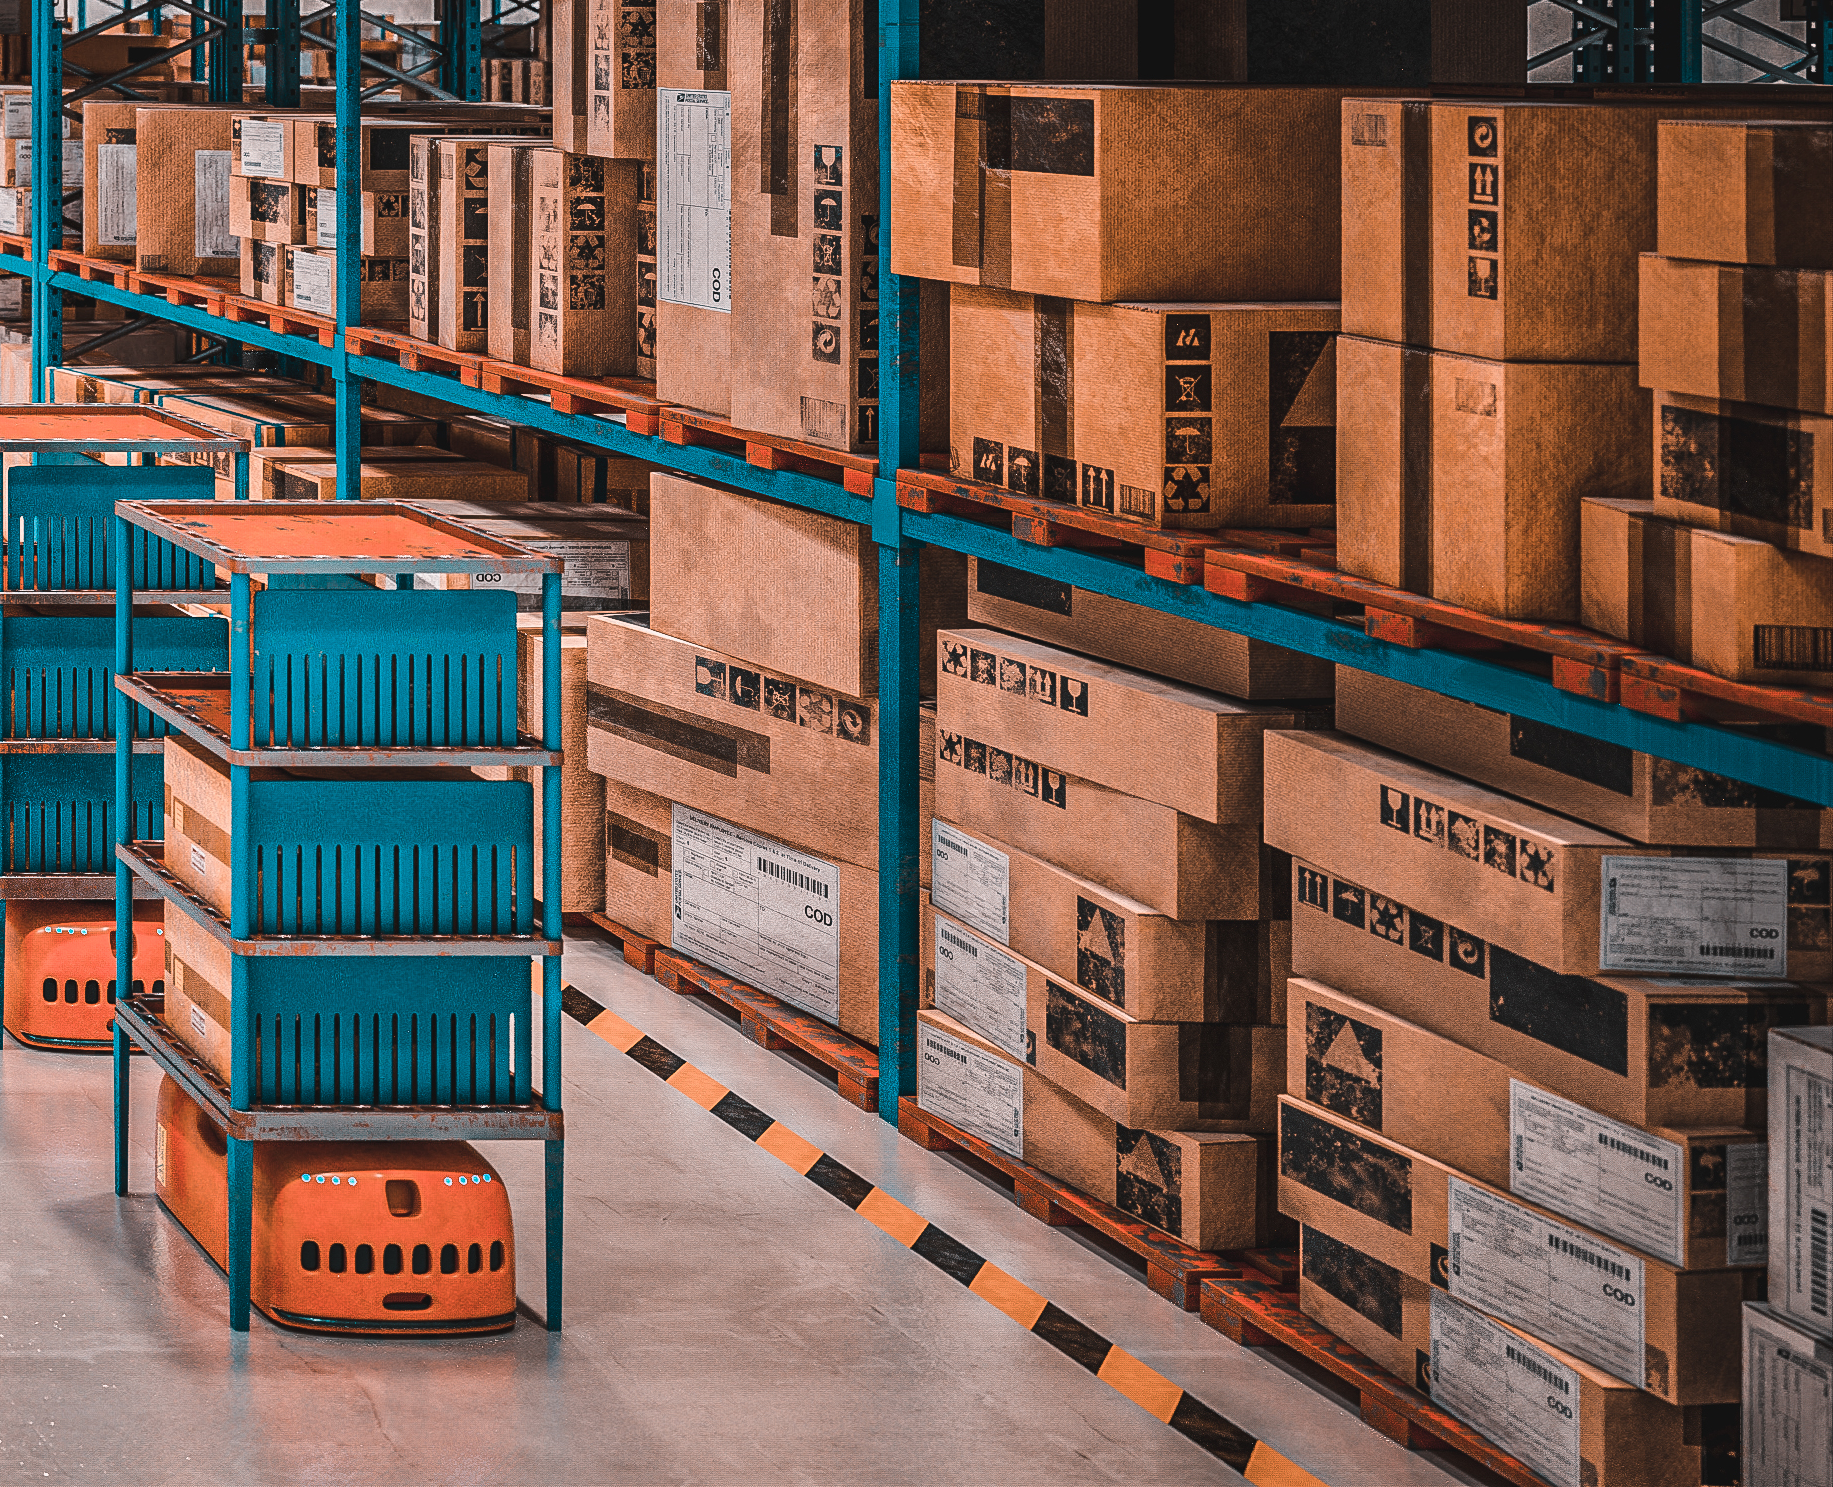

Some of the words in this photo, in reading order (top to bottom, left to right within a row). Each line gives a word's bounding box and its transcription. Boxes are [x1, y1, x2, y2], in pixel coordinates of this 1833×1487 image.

[803, 862, 821, 873] Delivery
[805, 905, 832, 926] COD
[1749, 928, 1779, 939] COD
[1645, 1172, 1673, 1191] COD
[1602, 1283, 1635, 1308] COD
[1547, 1396, 1572, 1419] COD
